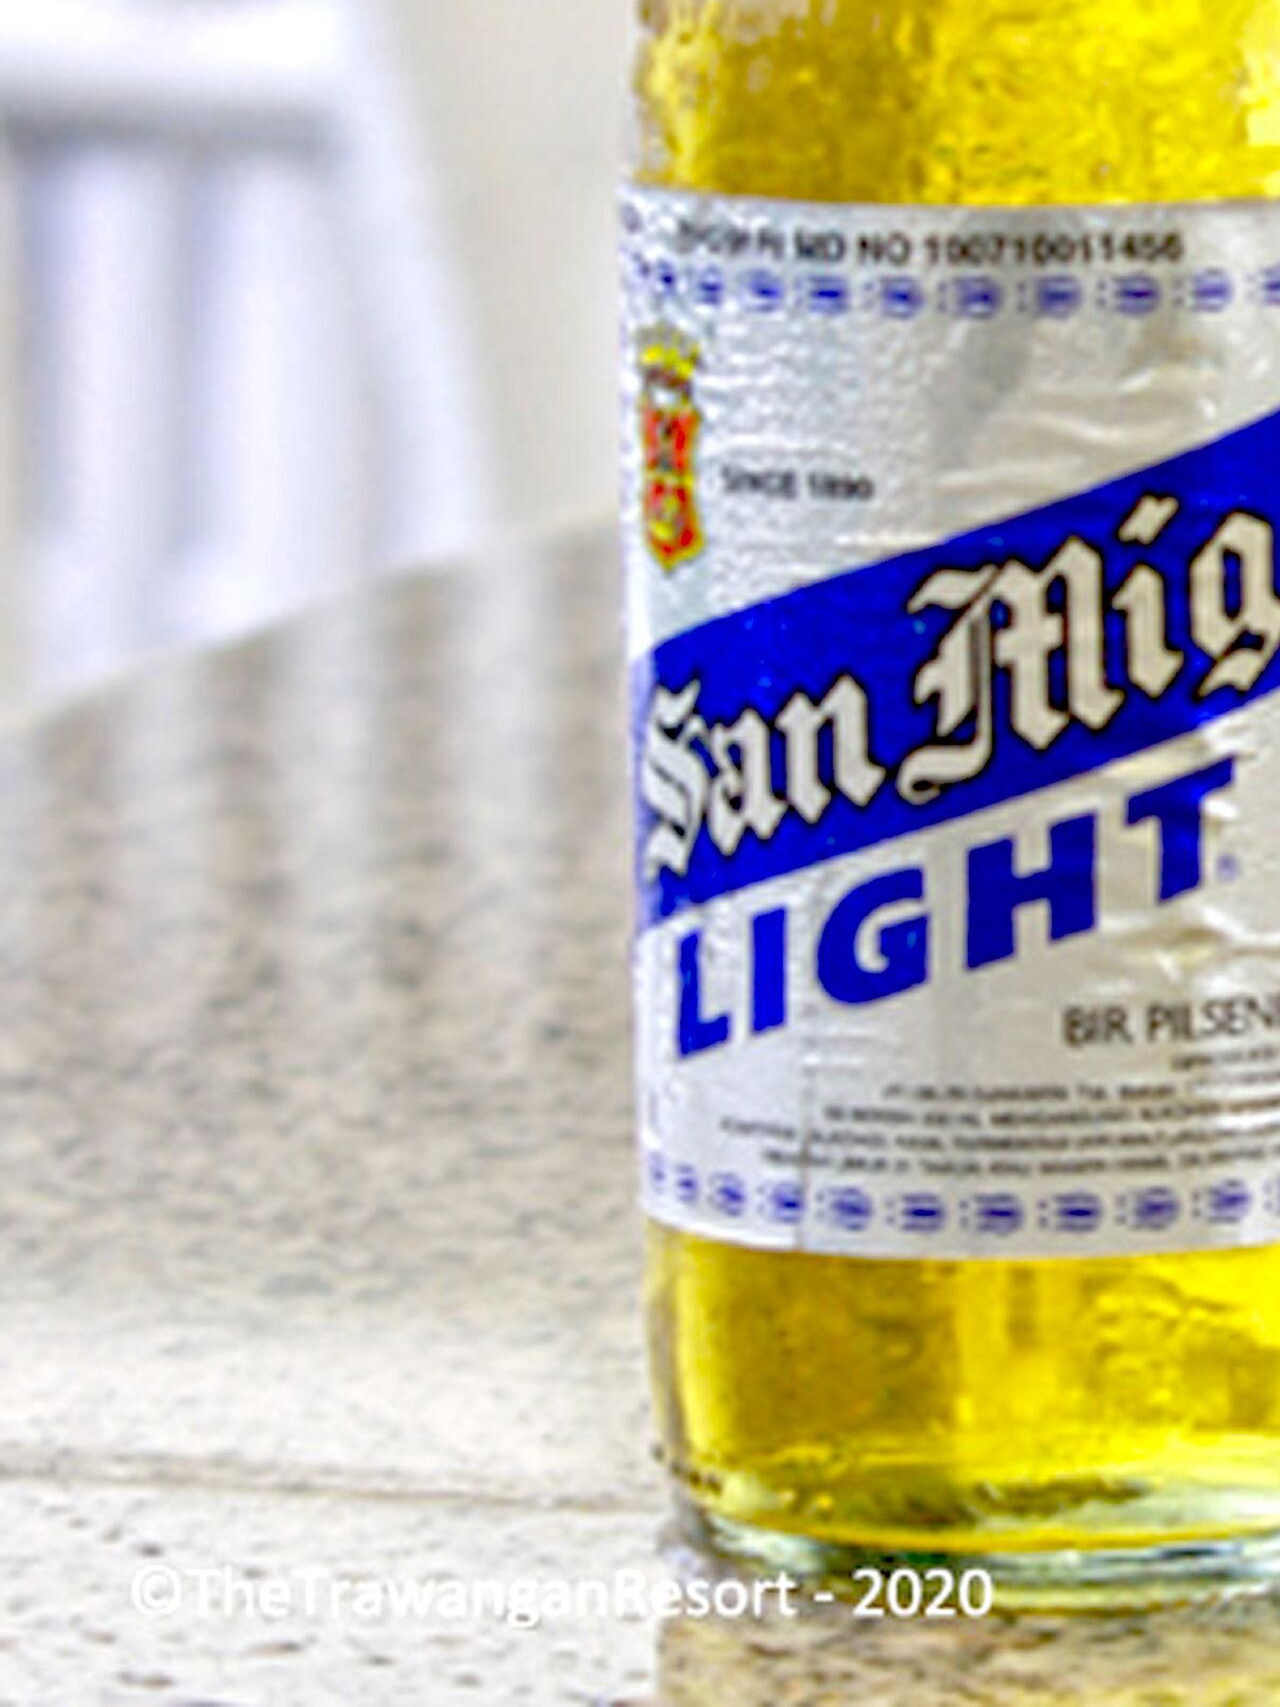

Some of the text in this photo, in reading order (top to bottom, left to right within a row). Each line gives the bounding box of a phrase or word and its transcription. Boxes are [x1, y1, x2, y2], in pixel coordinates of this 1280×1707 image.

[640, 673, 887, 884] San
[675, 755, 1236, 1061] LIGHT
[1062, 1004, 1134, 1048] BIR
